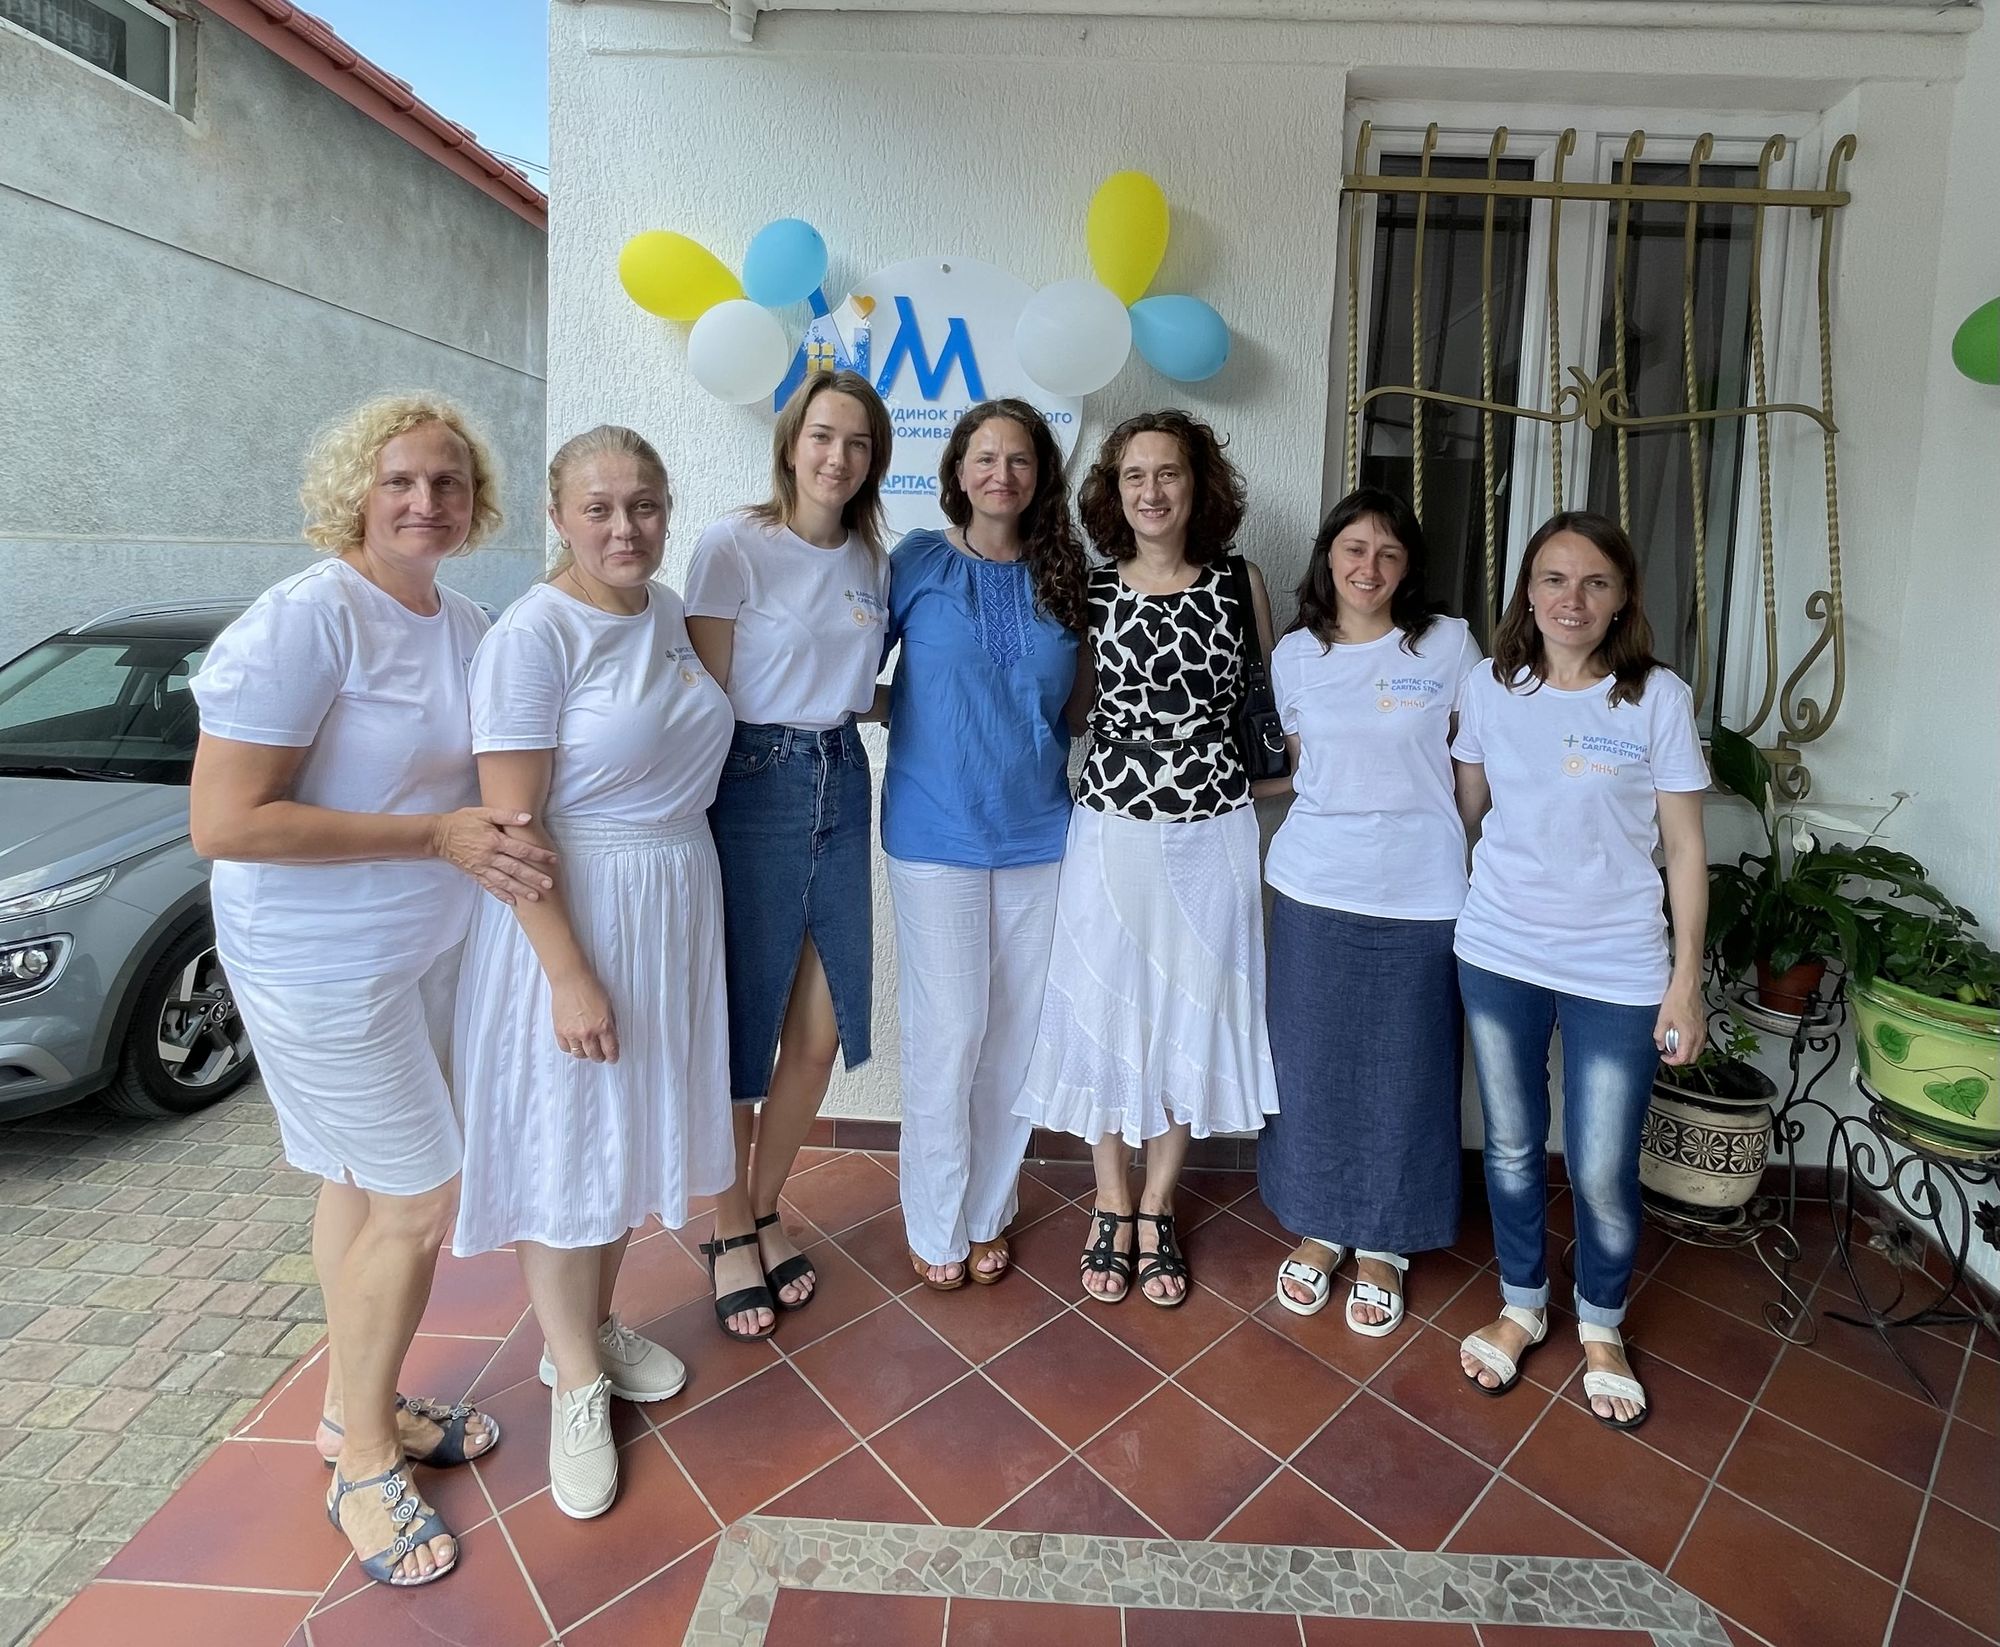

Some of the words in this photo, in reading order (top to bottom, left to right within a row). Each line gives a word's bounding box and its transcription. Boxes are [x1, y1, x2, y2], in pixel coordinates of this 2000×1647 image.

[881, 475, 937, 489] АРІТАС
[1583, 735, 1619, 747] КАРІТАС
[1582, 743, 1617, 754] CARITAS
